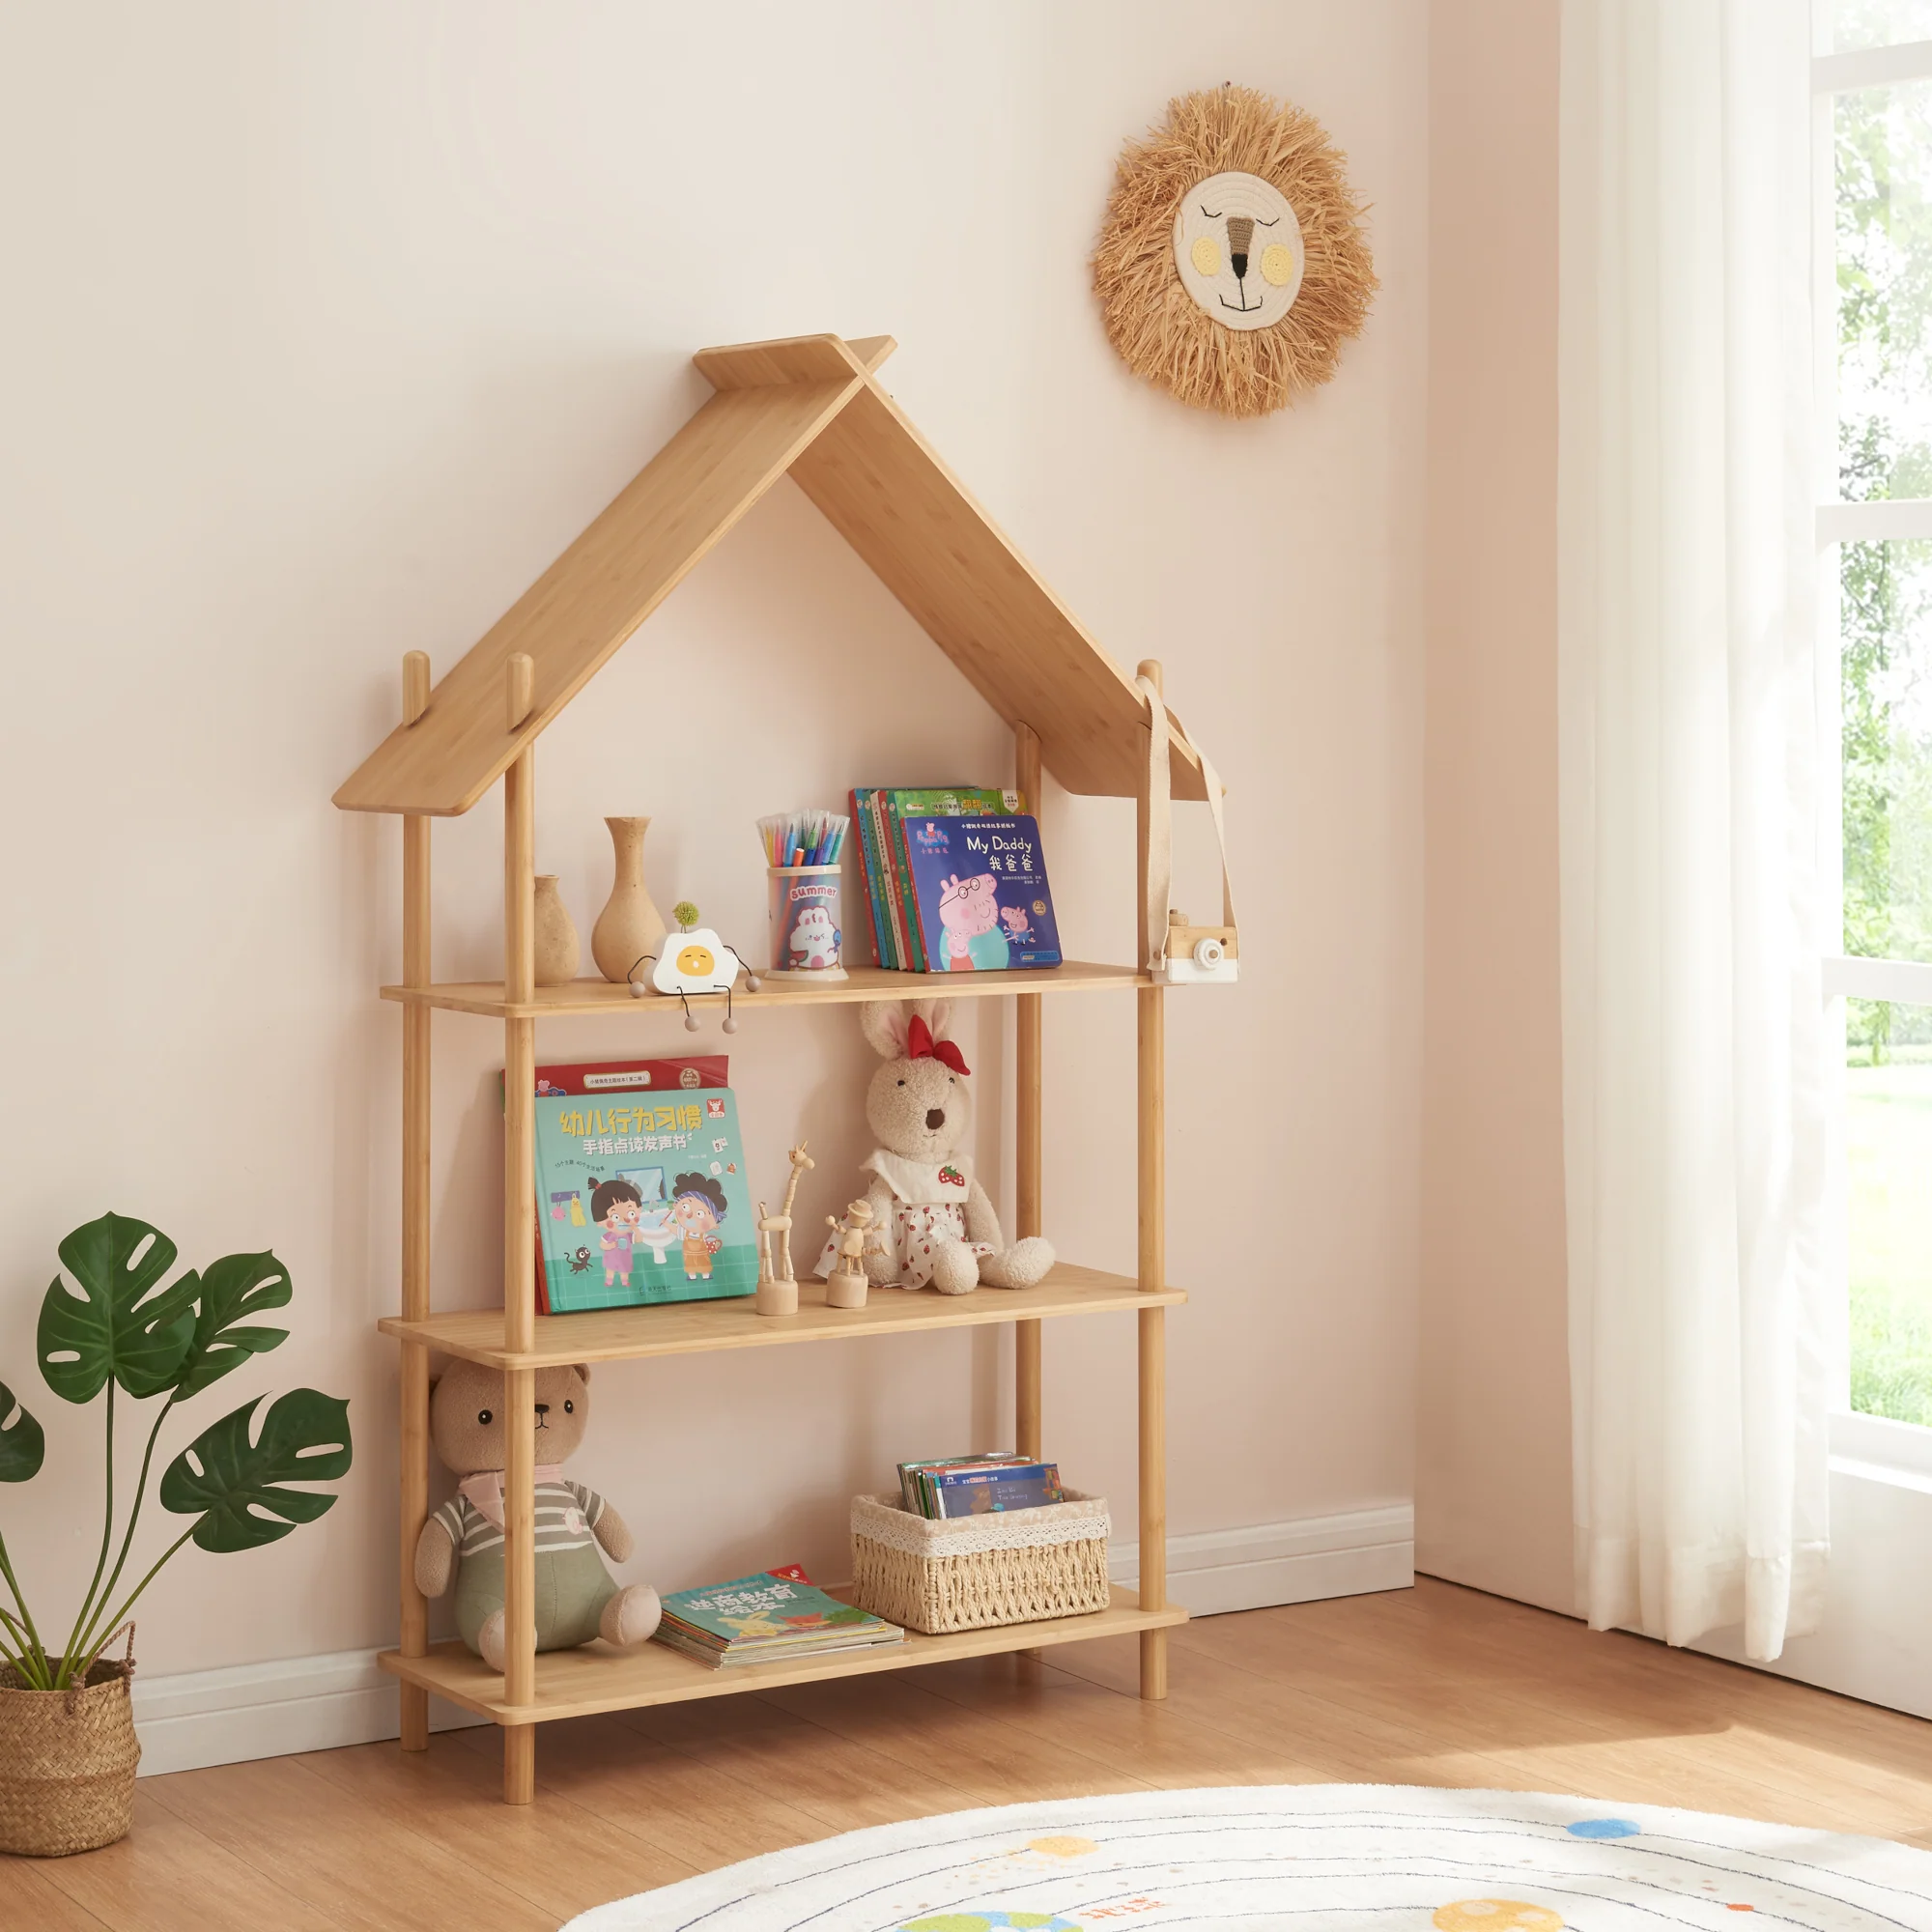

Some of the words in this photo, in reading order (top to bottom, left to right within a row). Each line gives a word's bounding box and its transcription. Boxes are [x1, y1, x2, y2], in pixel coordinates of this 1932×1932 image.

[966, 836, 989, 854] My
[991, 835, 1032, 854] Daddy
[988, 854, 1034, 872] 我爸爸
[791, 885, 837, 899] summer
[558, 1104, 703, 1137] 幼儿行为习惯
[582, 1133, 688, 1155] 手指点读发声书
[683, 1583, 798, 1611] 逆商教育
[719, 1602, 785, 1616] 绘本
